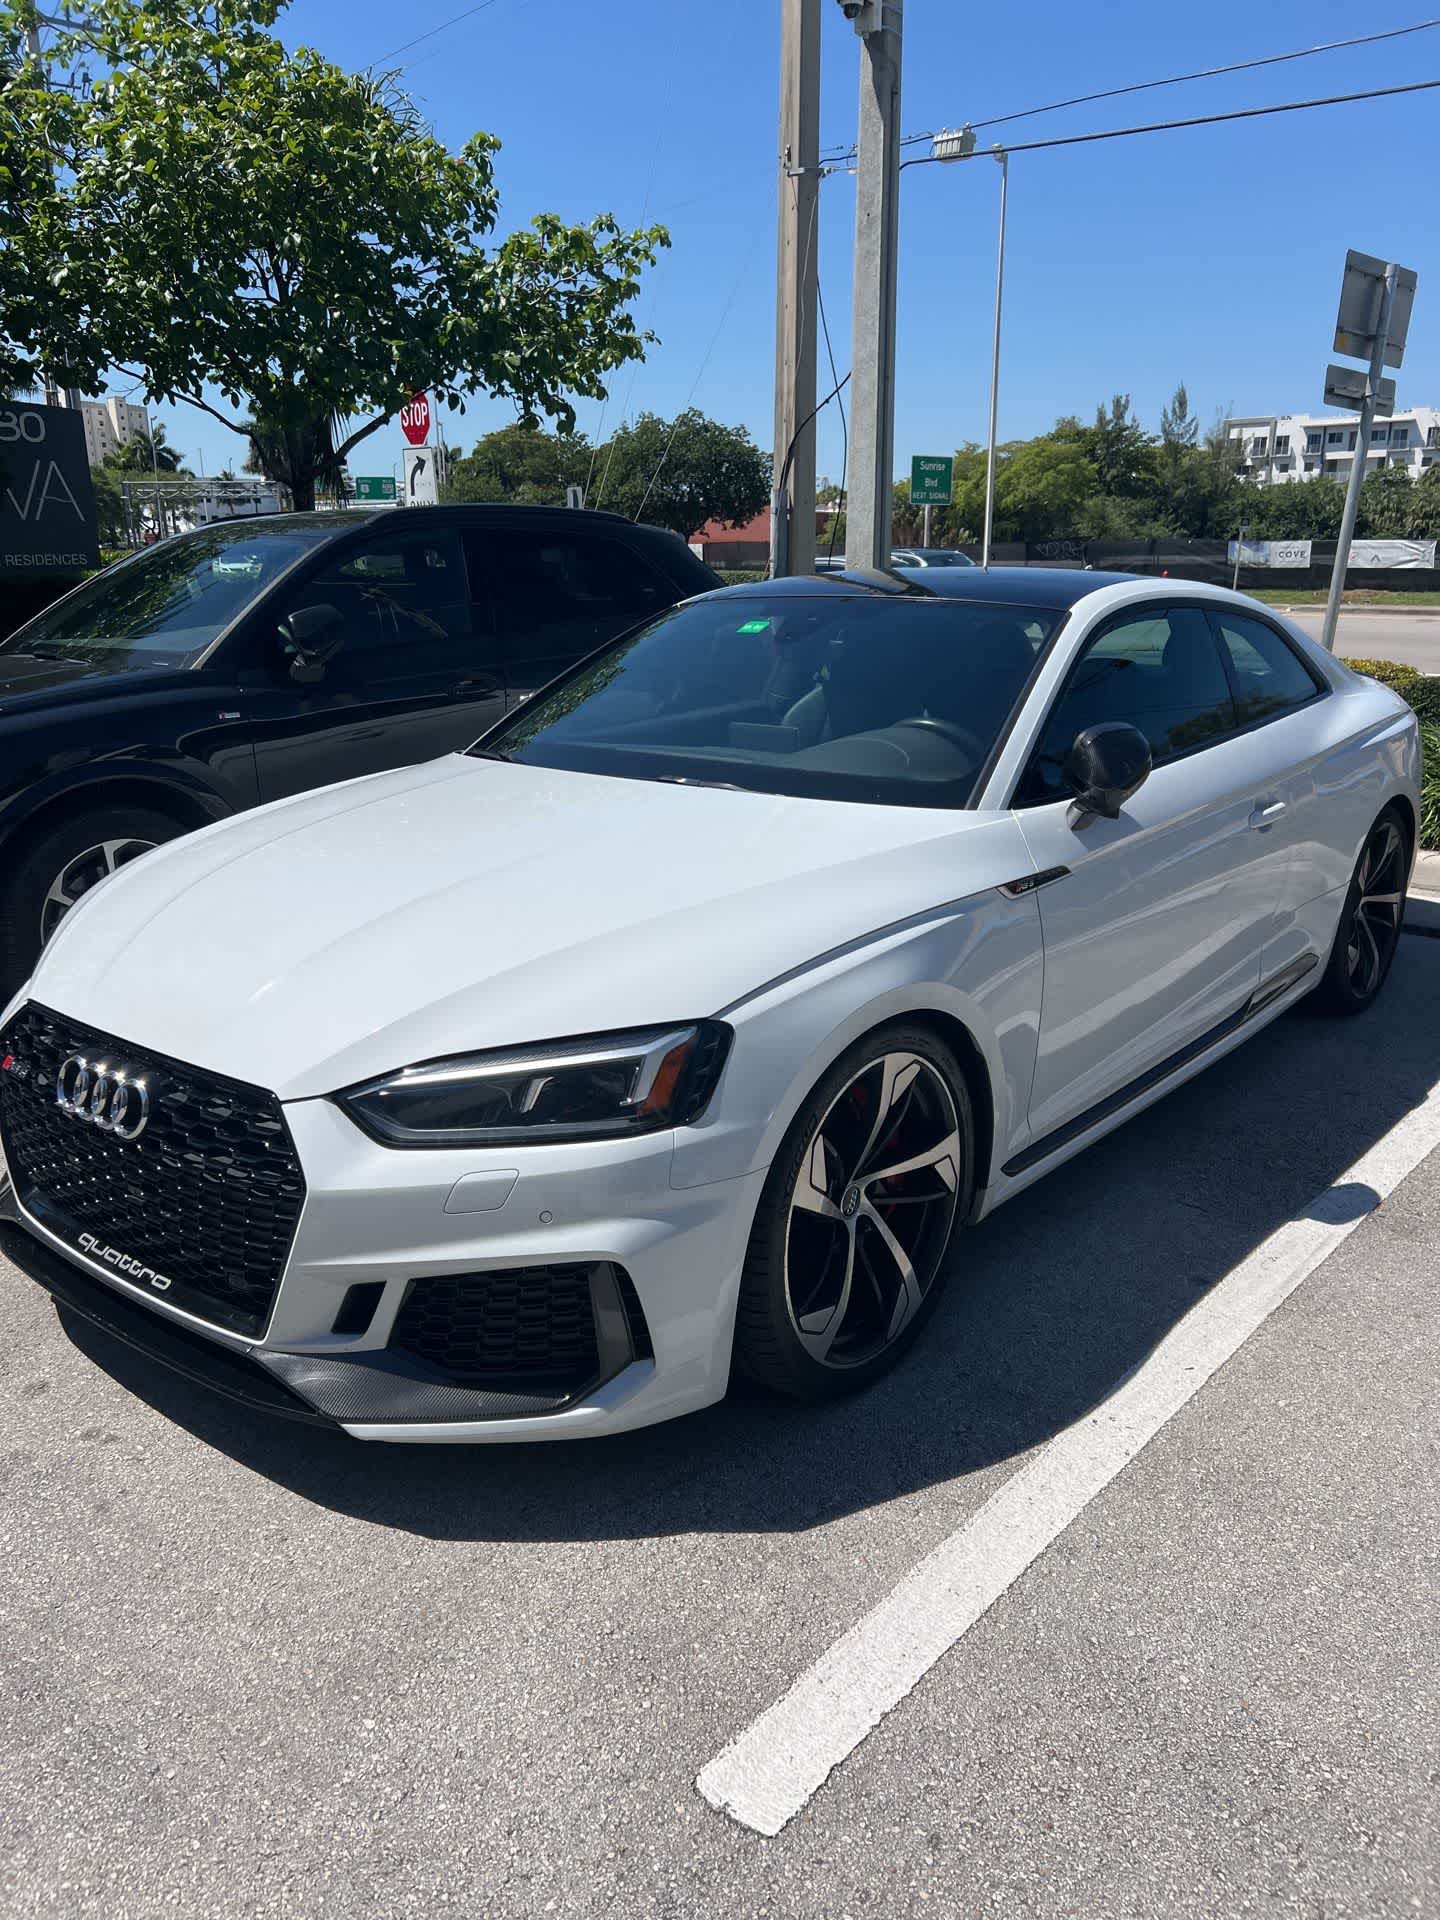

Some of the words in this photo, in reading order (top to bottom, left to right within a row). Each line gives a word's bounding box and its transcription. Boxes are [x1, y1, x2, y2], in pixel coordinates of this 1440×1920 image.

[402, 403, 428, 427] STOP
[920, 460, 946, 470] Sunrise
[925, 478, 938, 487] Blvd
[912, 491, 927, 499] NEXT
[5, 553, 88, 567] RESIDENCES
[1279, 551, 1306, 559] COVE
[78, 1232, 172, 1291] quattro
